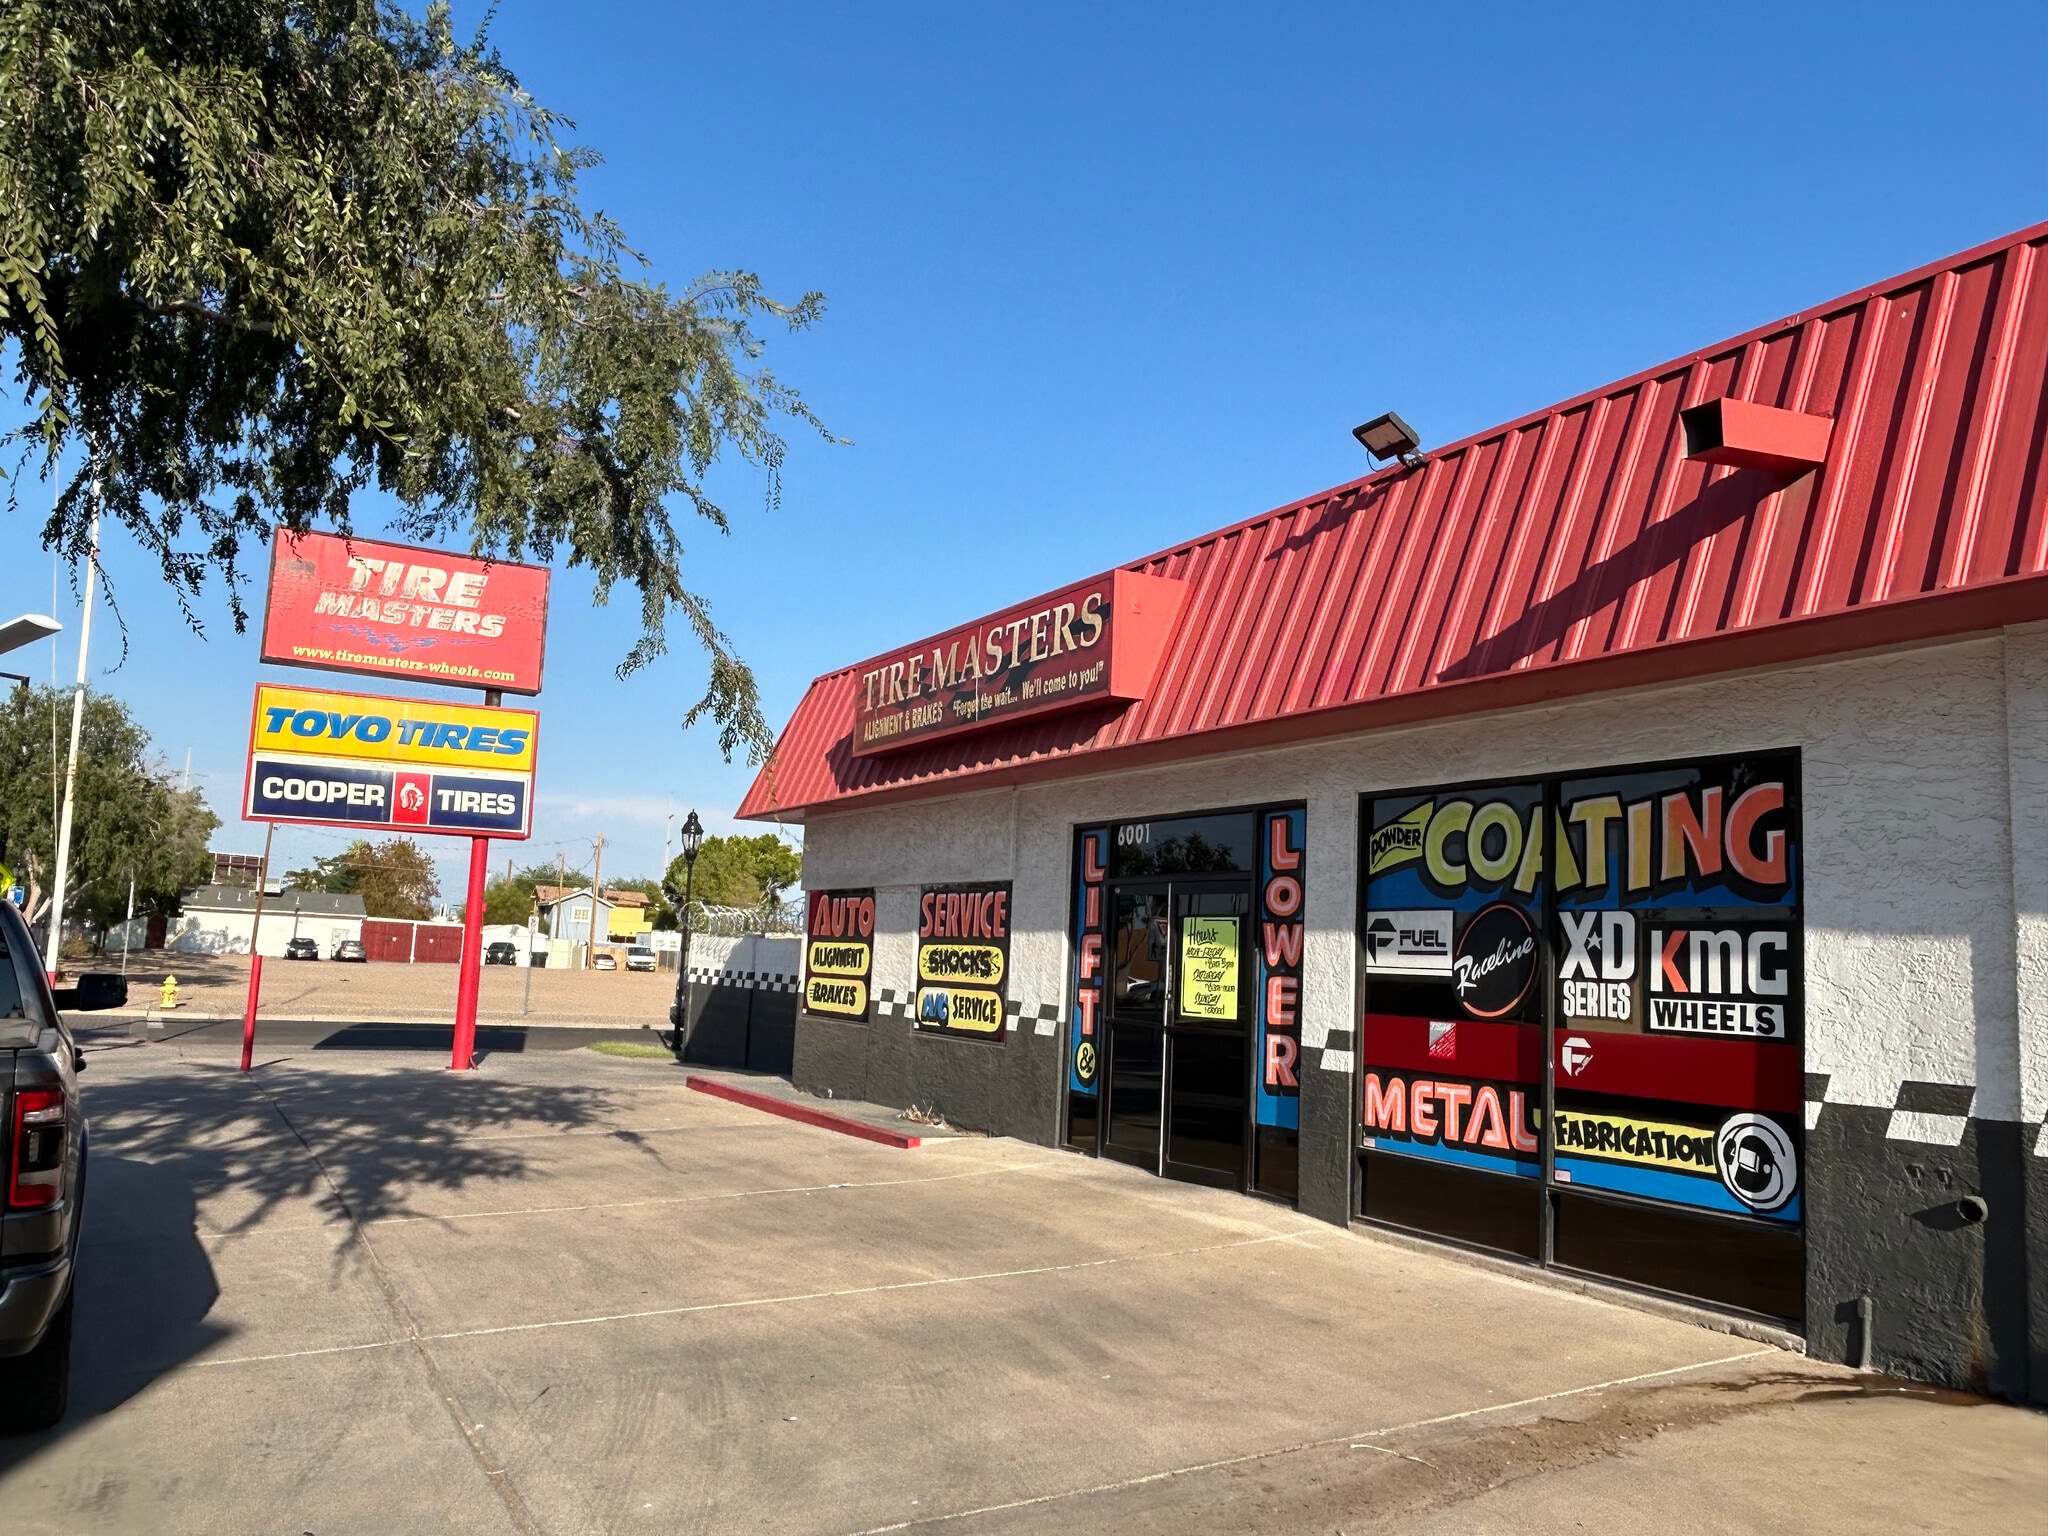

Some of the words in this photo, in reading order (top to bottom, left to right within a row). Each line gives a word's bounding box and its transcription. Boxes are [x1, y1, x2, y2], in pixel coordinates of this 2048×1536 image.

[347, 557, 489, 609] TIRE
[314, 592, 507, 638] MASTERS
[292, 645, 515, 682] www.tiremasters-wheels.com
[863, 653, 924, 712] TIRE
[928, 592, 1104, 692] MASTERS
[1043, 674, 1066, 695] come
[1068, 669, 1077, 688] to
[266, 706, 392, 743] TOYO
[397, 718, 530, 755] TIRES
[864, 711, 904, 741] ALIGNMENT
[905, 709, 910, 731] &
[912, 701, 943, 729] BRAKES
[262, 776, 385, 807] COOPER
[436, 788, 516, 815] TIRES
[1117, 823, 1150, 846] 6001
[1370, 826, 1422, 866] POWDER
[1424, 782, 1788, 893] COATING
[812, 894, 875, 937] AUTO
[920, 891, 1007, 938] SERVICE
[1187, 918, 1219, 946] Hours
[1079, 837, 1105, 1036] LIFT
[1264, 818, 1303, 1088] LOWER
[1400, 930, 1447, 948] FUEL
[1558, 910, 1636, 980] XD
[813, 947, 864, 969] ALIGNMENT
[927, 948, 993, 977] SHOCKS
[1453, 936, 1535, 997] Raceline
[812, 981, 857, 1006] BRAKES
[952, 994, 996, 1024] SERVICE
[1563, 979, 1631, 1021] SERIES
[1655, 1000, 1776, 1036] WHEELS
[1364, 1072, 1539, 1154] METAL
[1554, 1114, 1716, 1167] FABRICATION
